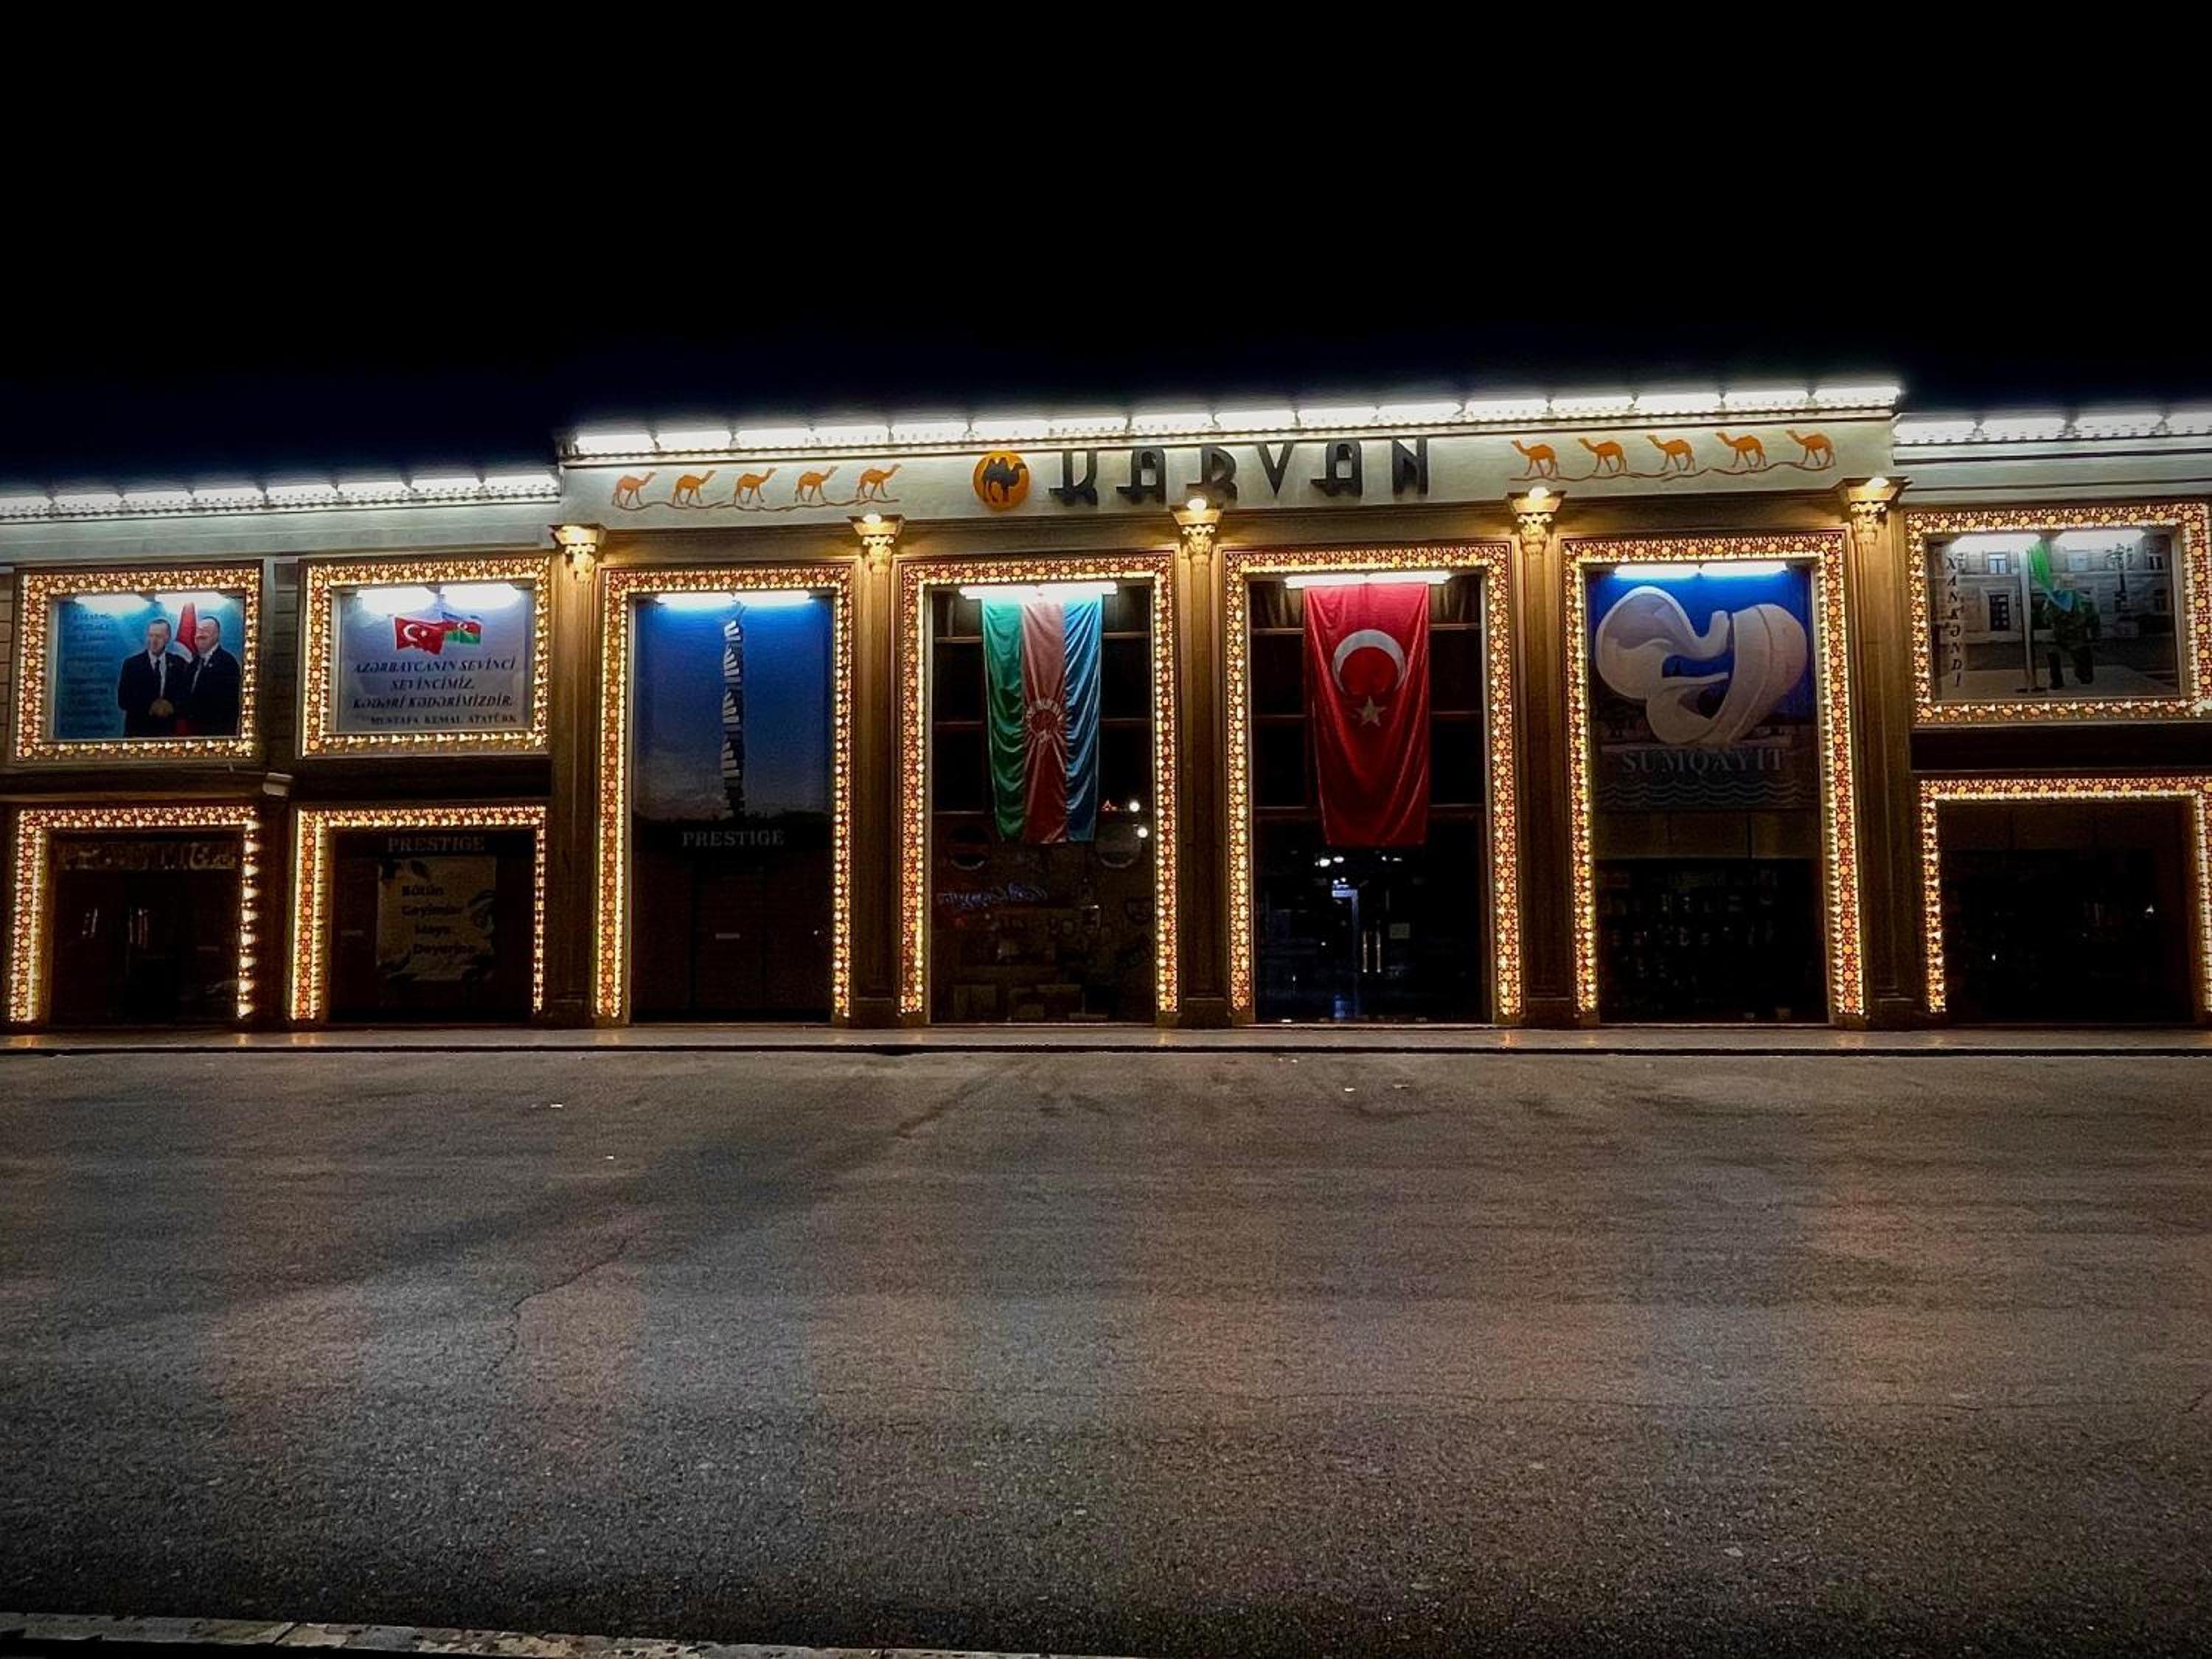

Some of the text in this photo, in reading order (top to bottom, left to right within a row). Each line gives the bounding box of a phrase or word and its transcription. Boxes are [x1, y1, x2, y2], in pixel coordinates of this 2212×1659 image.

[1048, 437, 1428, 507] KARVAN
[371, 716, 418, 726] MUSTAFA
[389, 835, 485, 853] PRESTIGE
[681, 828, 785, 849] PRESTIGE
